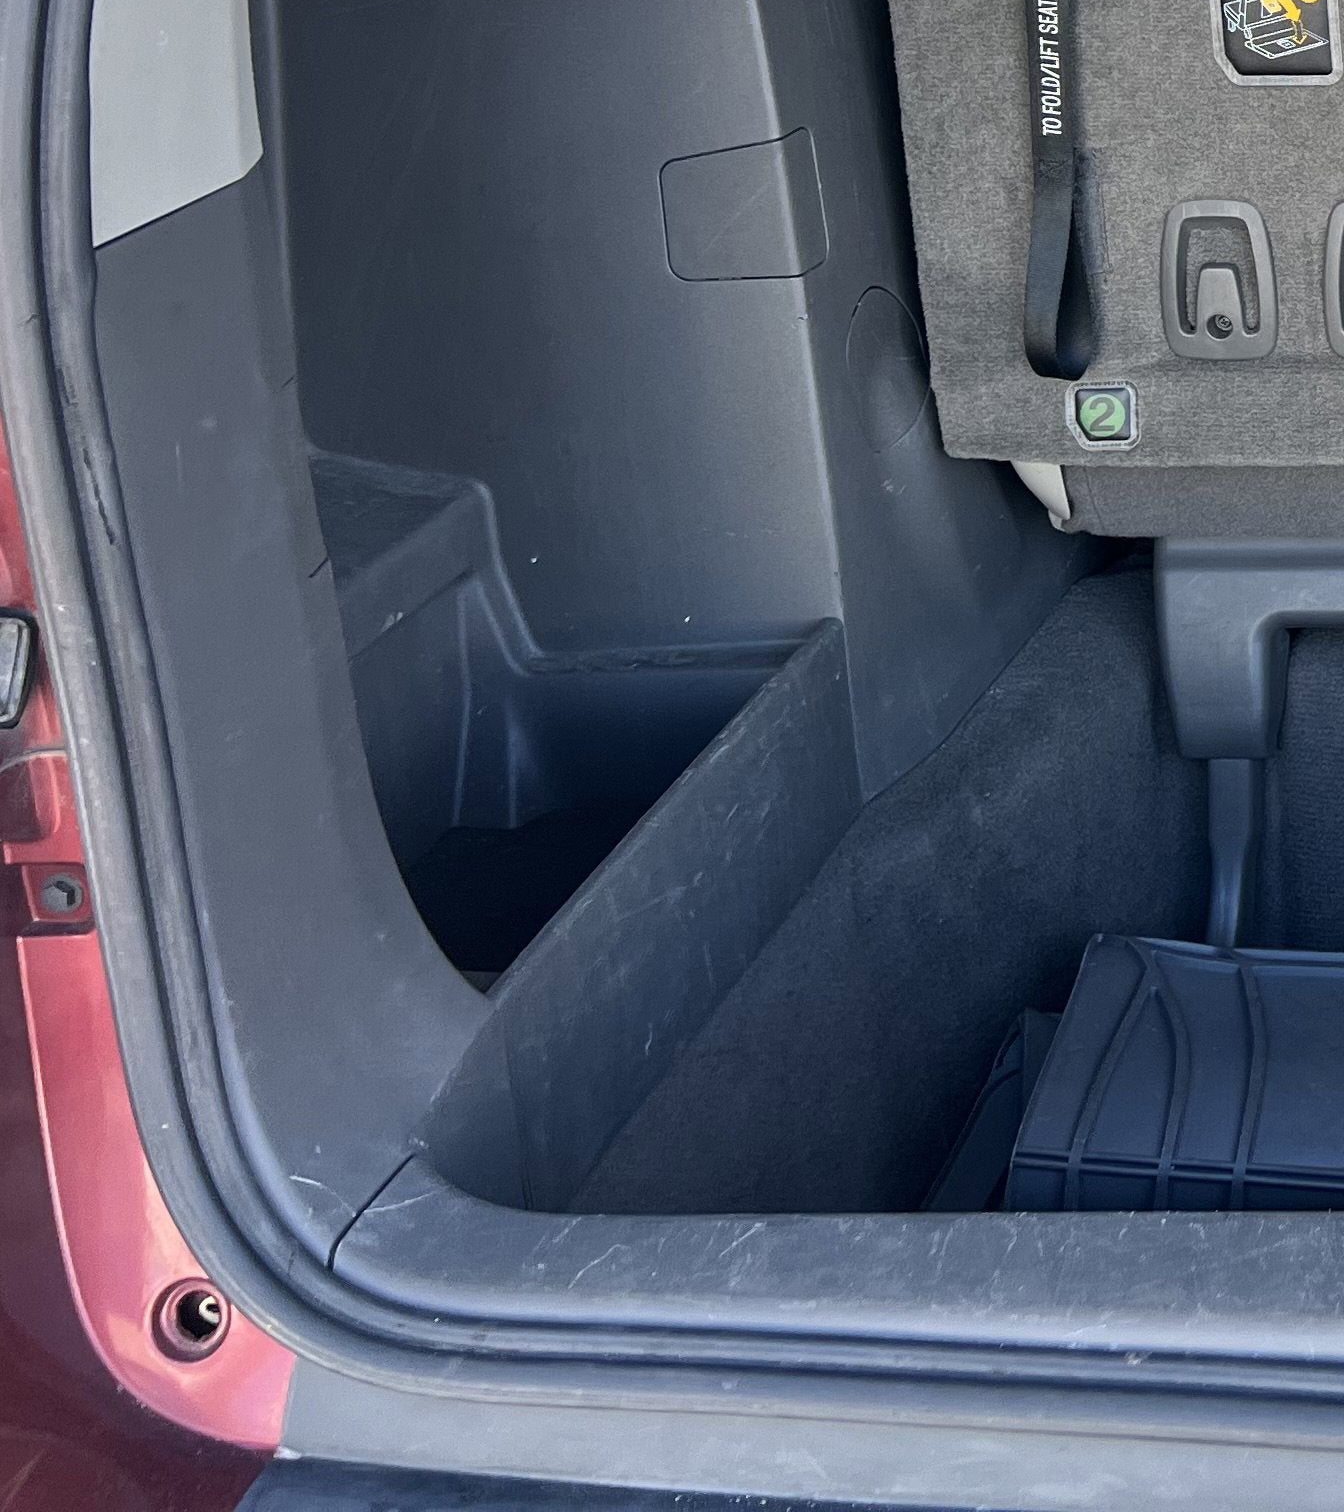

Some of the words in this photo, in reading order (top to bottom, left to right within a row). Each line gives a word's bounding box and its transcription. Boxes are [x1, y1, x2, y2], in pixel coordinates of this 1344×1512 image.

[1039, 37, 1061, 116] FOLD/LIFT
[1042, 116, 1062, 136] TO
[1089, 396, 1116, 432] 2
